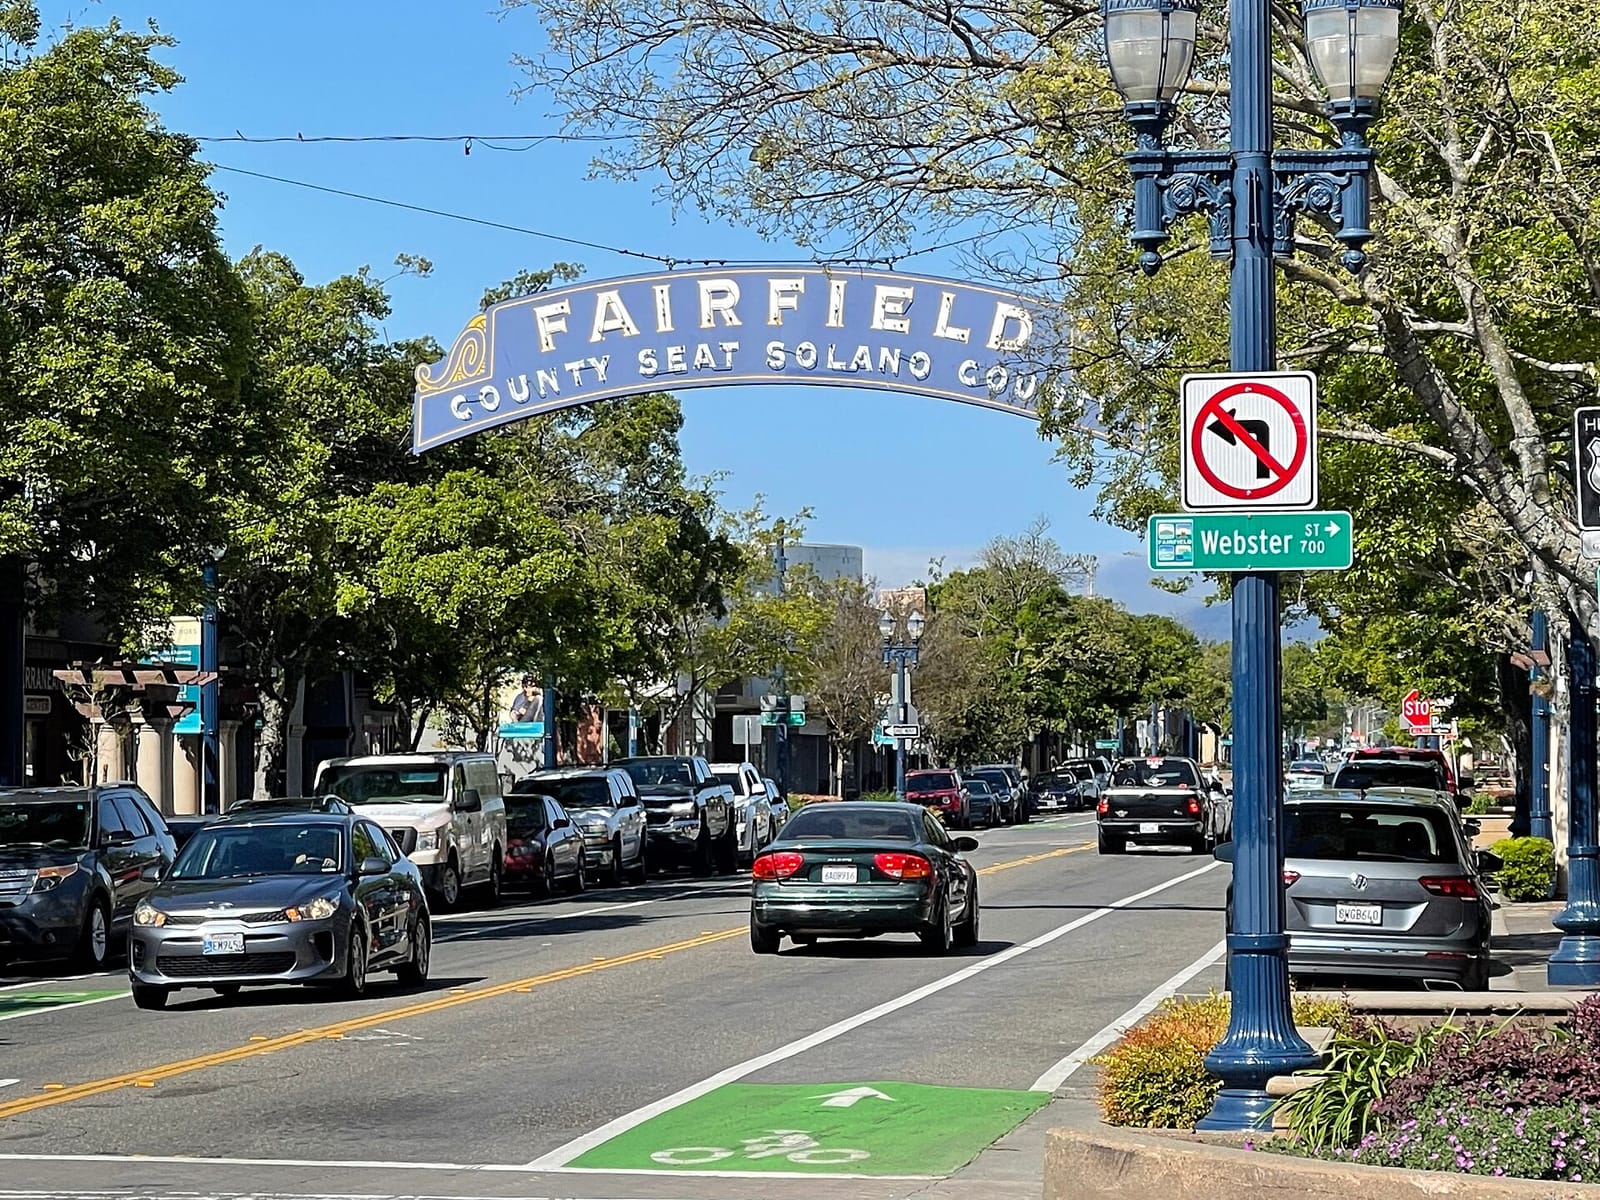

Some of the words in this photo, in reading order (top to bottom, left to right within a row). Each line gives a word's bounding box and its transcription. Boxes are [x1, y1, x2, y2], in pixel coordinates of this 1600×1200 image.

[533, 277, 1035, 353] FAIRFIELD
[450, 354, 611, 421] COUNTY
[638, 341, 739, 377] SEAT
[766, 341, 931, 380] SOLANO
[1304, 523, 1320, 537] ST
[1200, 529, 1293, 555] Webster
[1300, 540, 1325, 554] 700
[1405, 701, 1430, 716] STO
